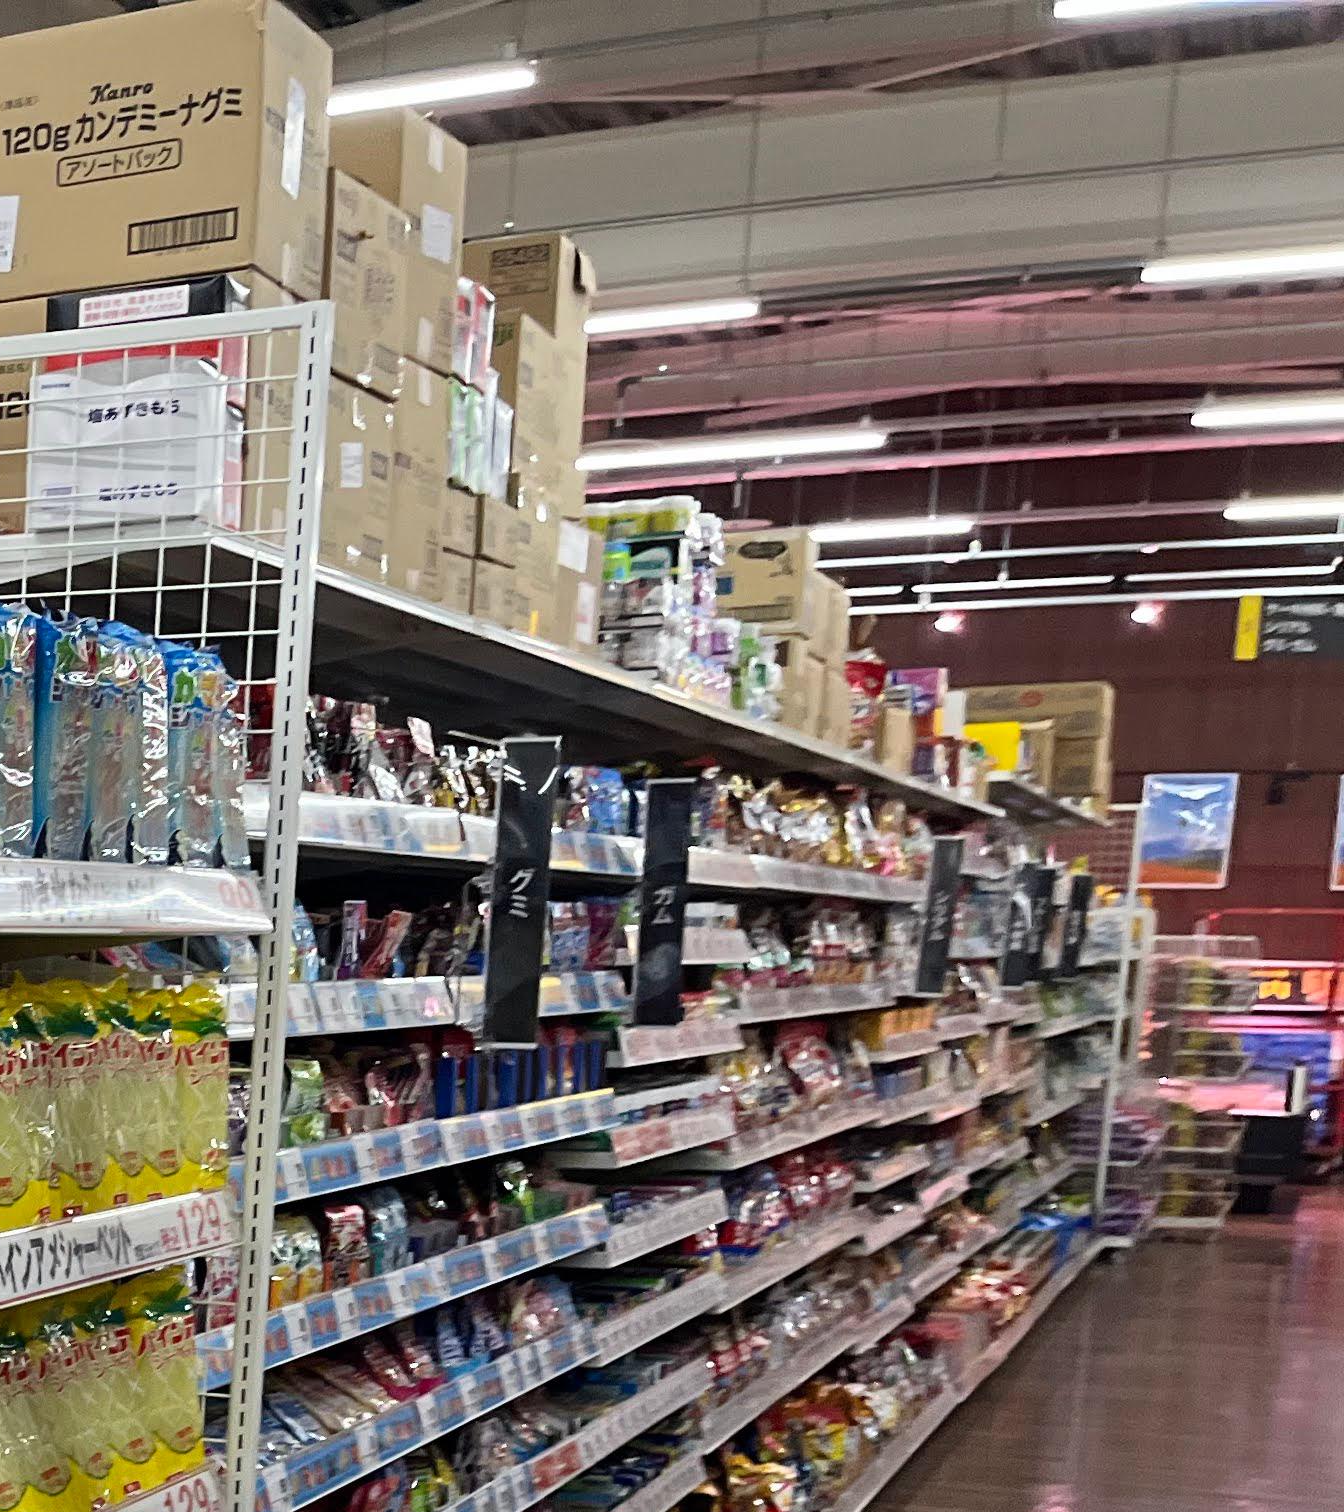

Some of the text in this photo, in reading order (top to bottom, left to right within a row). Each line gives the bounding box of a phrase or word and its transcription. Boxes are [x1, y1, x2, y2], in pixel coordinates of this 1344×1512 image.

[89, 81, 155, 104] Kanro
[1, 87, 243, 158] 120gカンデミーナグミ
[64, 144, 175, 181] アソートパック
[176, 1200, 222, 1250] 129
